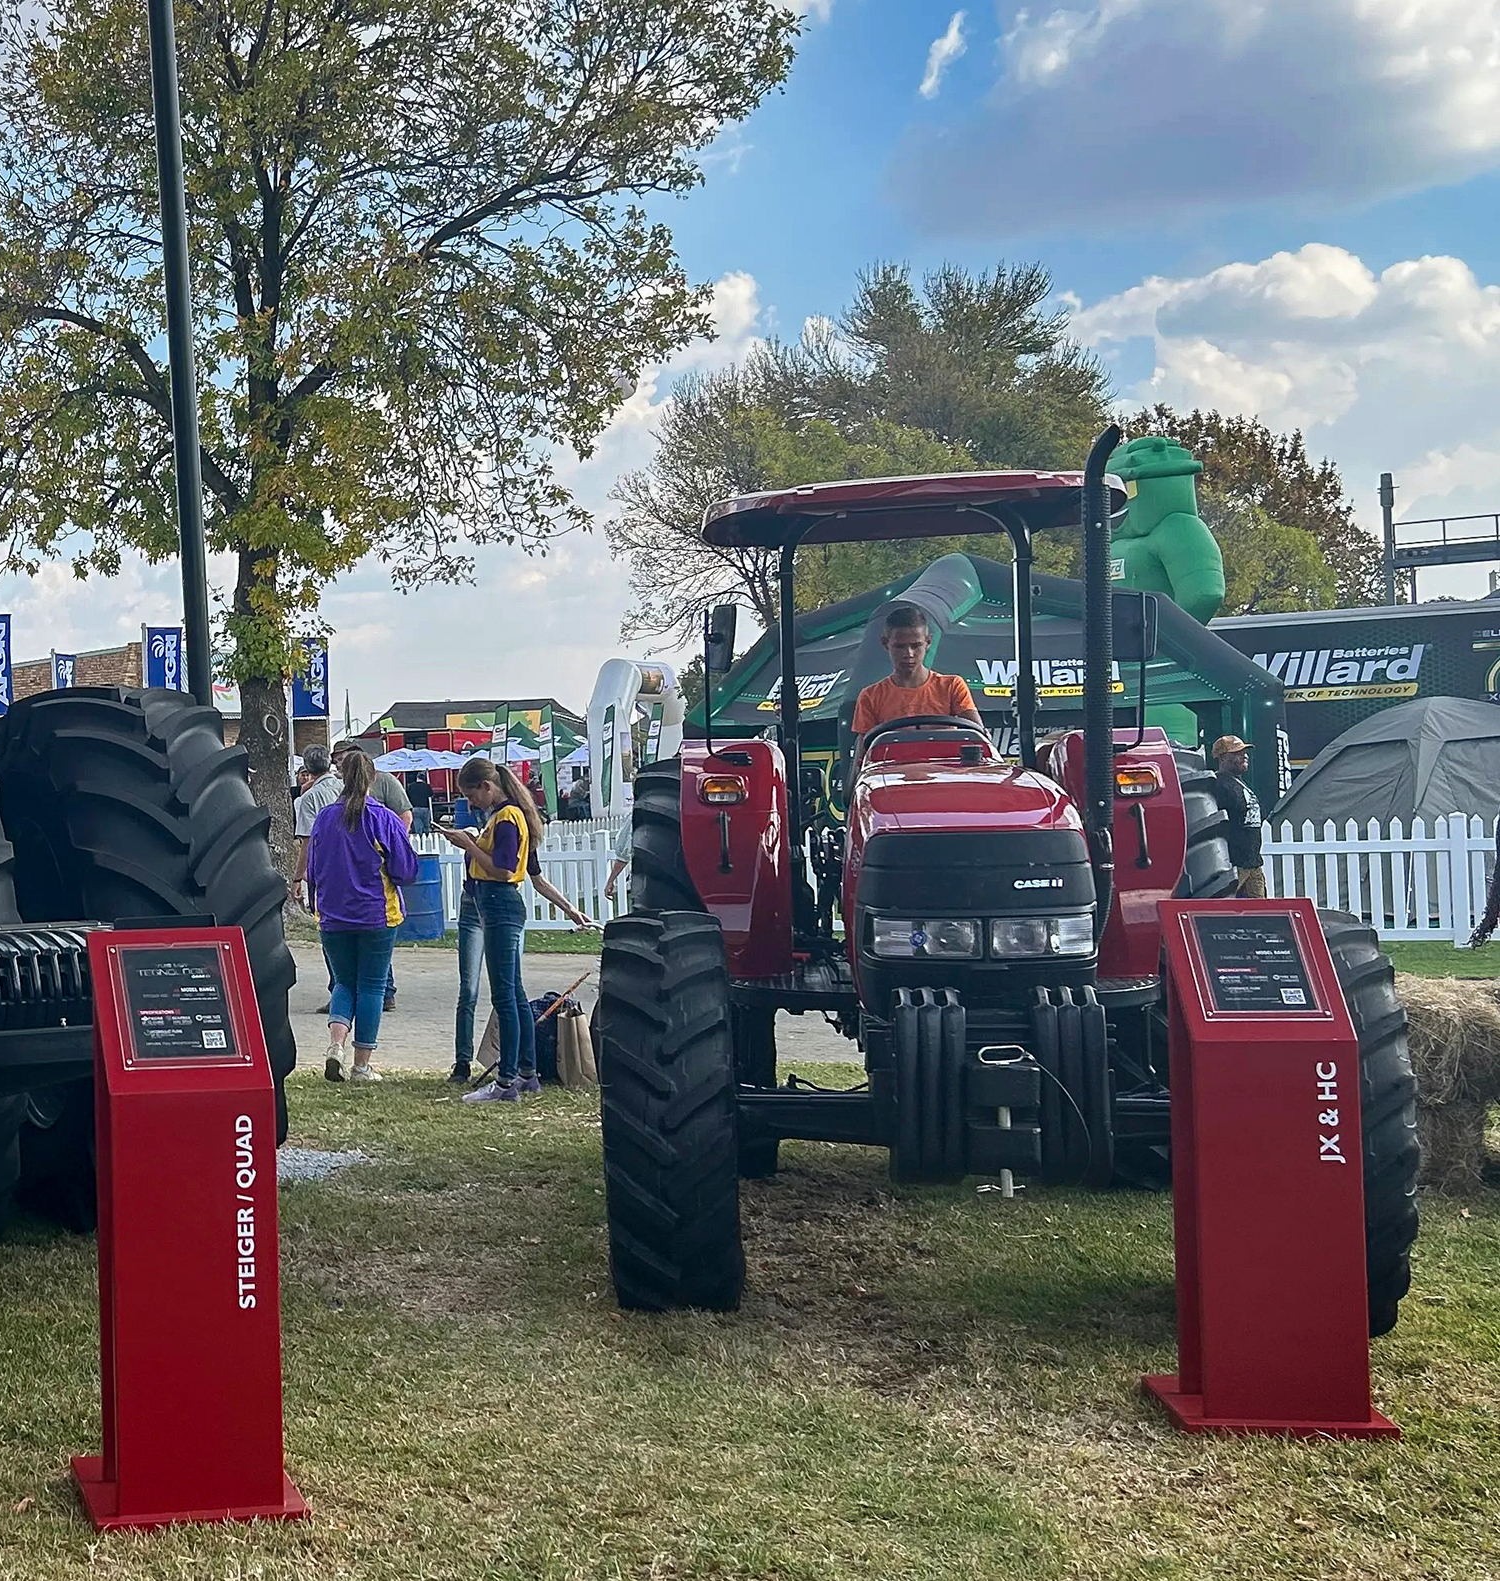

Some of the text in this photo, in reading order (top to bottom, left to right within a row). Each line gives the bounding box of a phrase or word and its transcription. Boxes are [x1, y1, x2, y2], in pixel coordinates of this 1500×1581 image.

[1332, 646, 1409, 659] Batteries
[165, 634, 178, 690] FGRI
[1051, 659, 1087, 667] Batte
[1307, 690, 1324, 698] OF
[1328, 686, 1411, 697] TECHNOLOGY
[1013, 879, 1050, 889] CASE
[1316, 1061, 1347, 1164] JX & HC
[235, 1114, 257, 1309] STEIGER / QUAD
